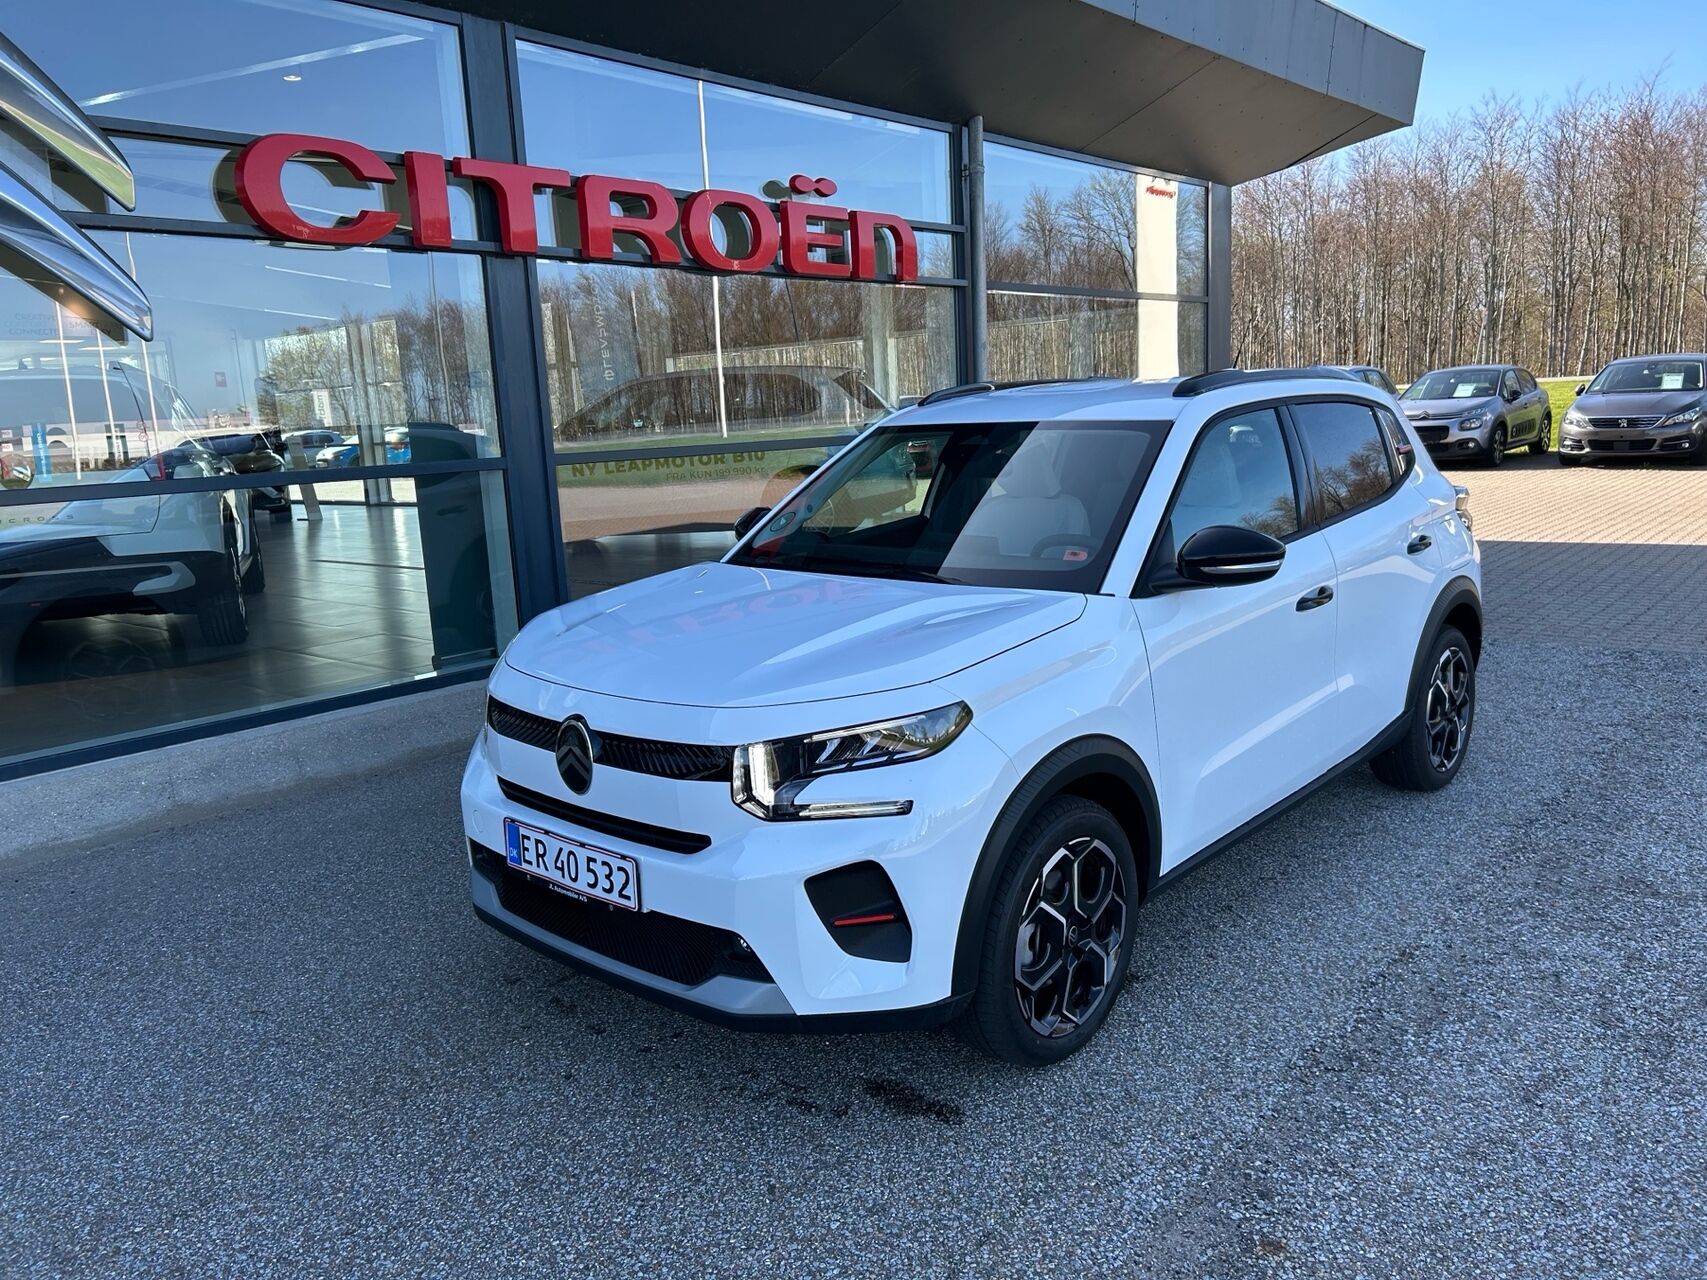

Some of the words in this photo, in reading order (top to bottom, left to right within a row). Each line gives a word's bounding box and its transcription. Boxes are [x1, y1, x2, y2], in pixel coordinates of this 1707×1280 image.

[571, 464, 596, 477] NY
[604, 453, 725, 475] LEAPMOTOR
[666, 472, 686, 482] FRA
[689, 470, 712, 480] KUN
[509, 846, 519, 859] DK
[521, 833, 549, 872] ER
[554, 846, 579, 883] 40
[586, 855, 632, 902] 532
